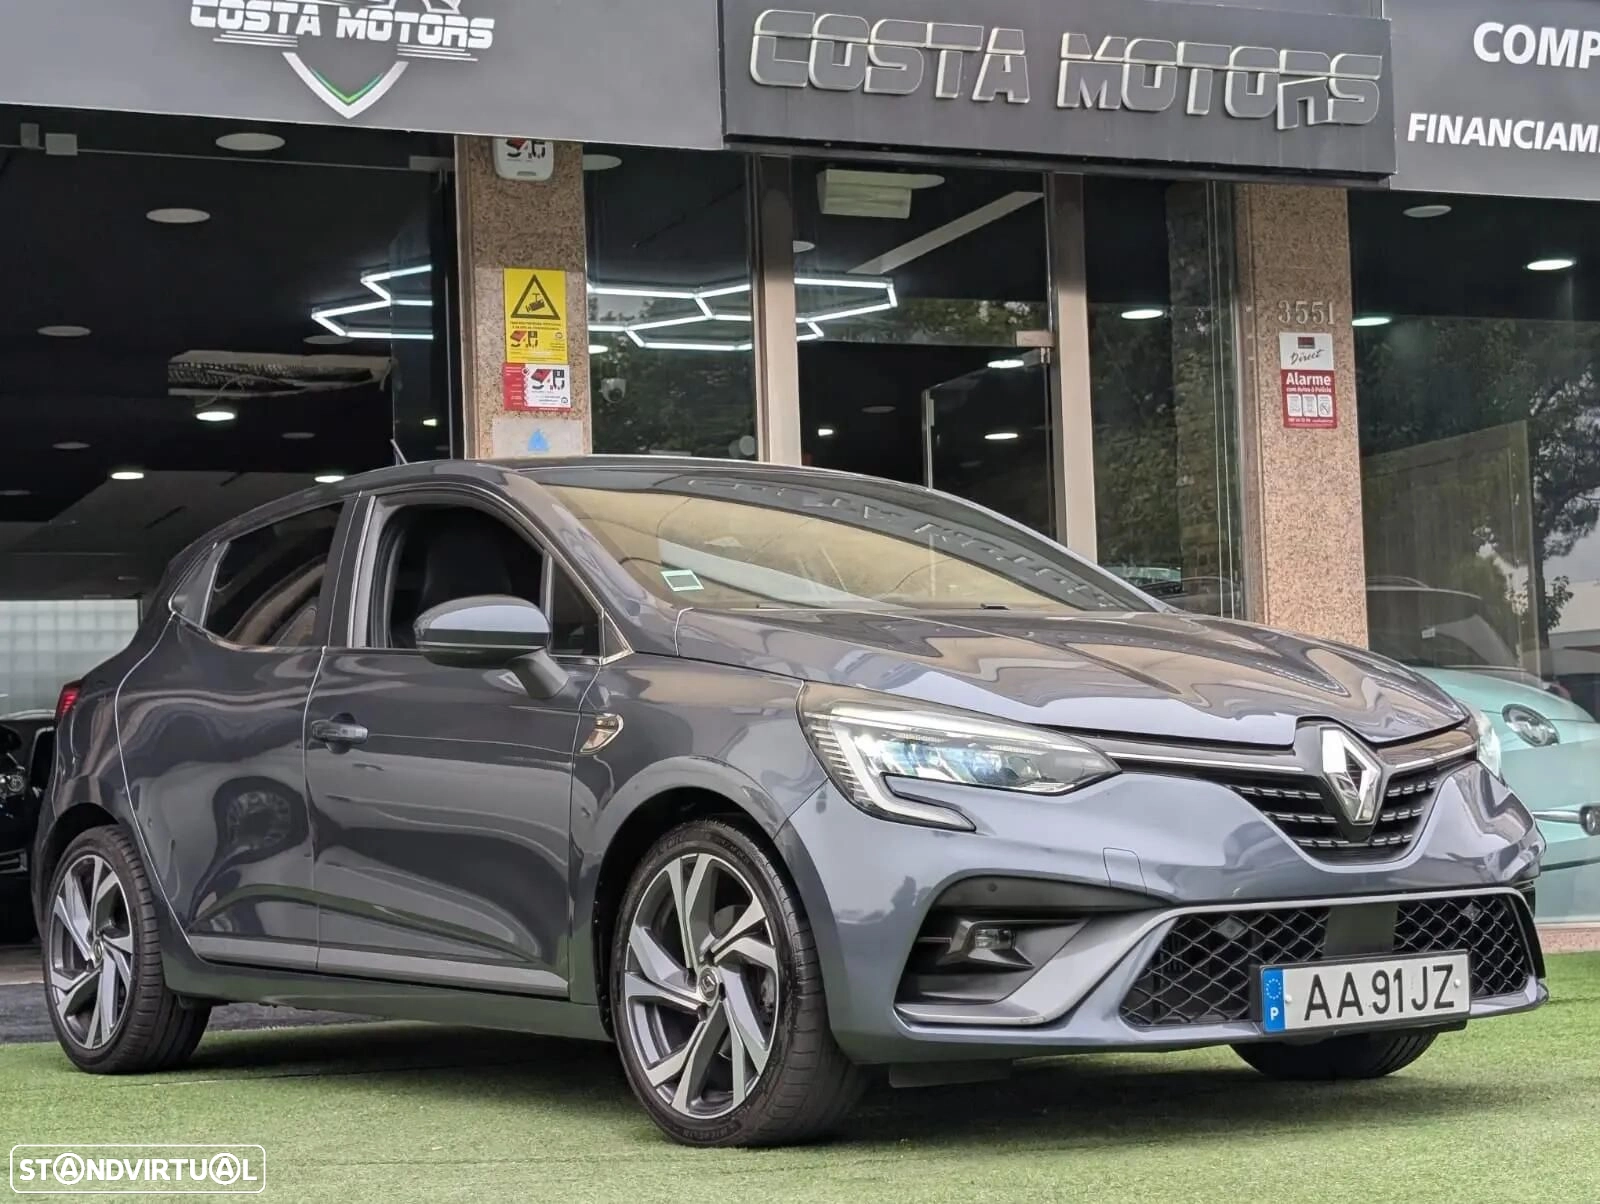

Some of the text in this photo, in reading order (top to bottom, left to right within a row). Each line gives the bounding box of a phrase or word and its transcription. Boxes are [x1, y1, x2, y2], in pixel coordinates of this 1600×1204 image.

[190, 0, 495, 49] COSTA MOTORS
[1473, 21, 1600, 69] COMP
[750, 9, 1382, 130] COSTA MOTORS
[1407, 112, 1600, 153] FINANCIAM
[1278, 299, 1336, 326] 3551
[1286, 372, 1332, 386] Alarme
[1270, 1007, 1279, 1020] P
